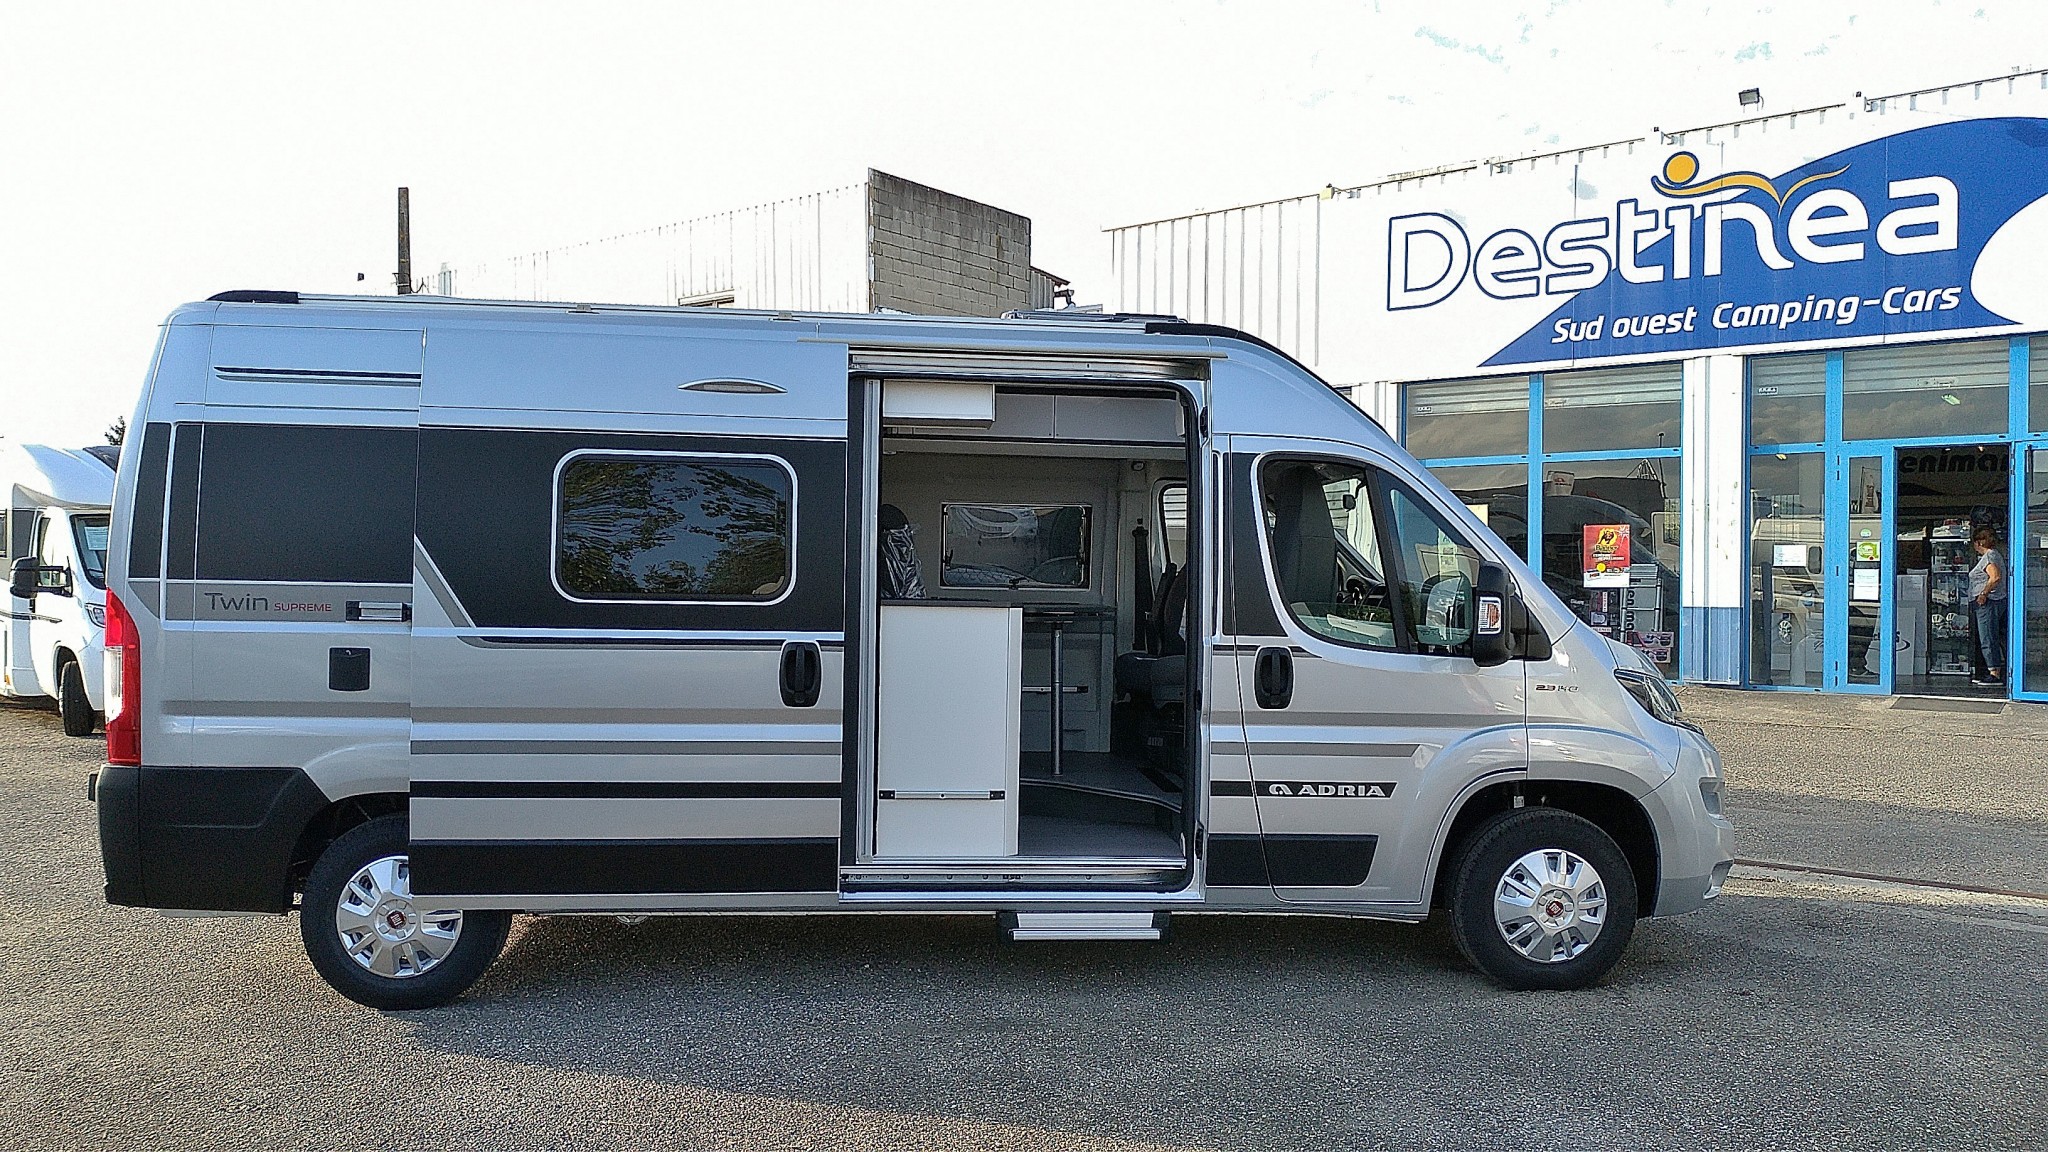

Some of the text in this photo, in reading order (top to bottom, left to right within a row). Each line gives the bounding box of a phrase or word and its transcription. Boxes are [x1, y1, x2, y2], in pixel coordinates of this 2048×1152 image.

[1387, 175, 1960, 311] Destinea
[1551, 286, 1962, 344] Sud ouest Camping-Cars
[204, 592, 333, 612] Twin SUPREME
[1298, 784, 1386, 797] ADRIA
